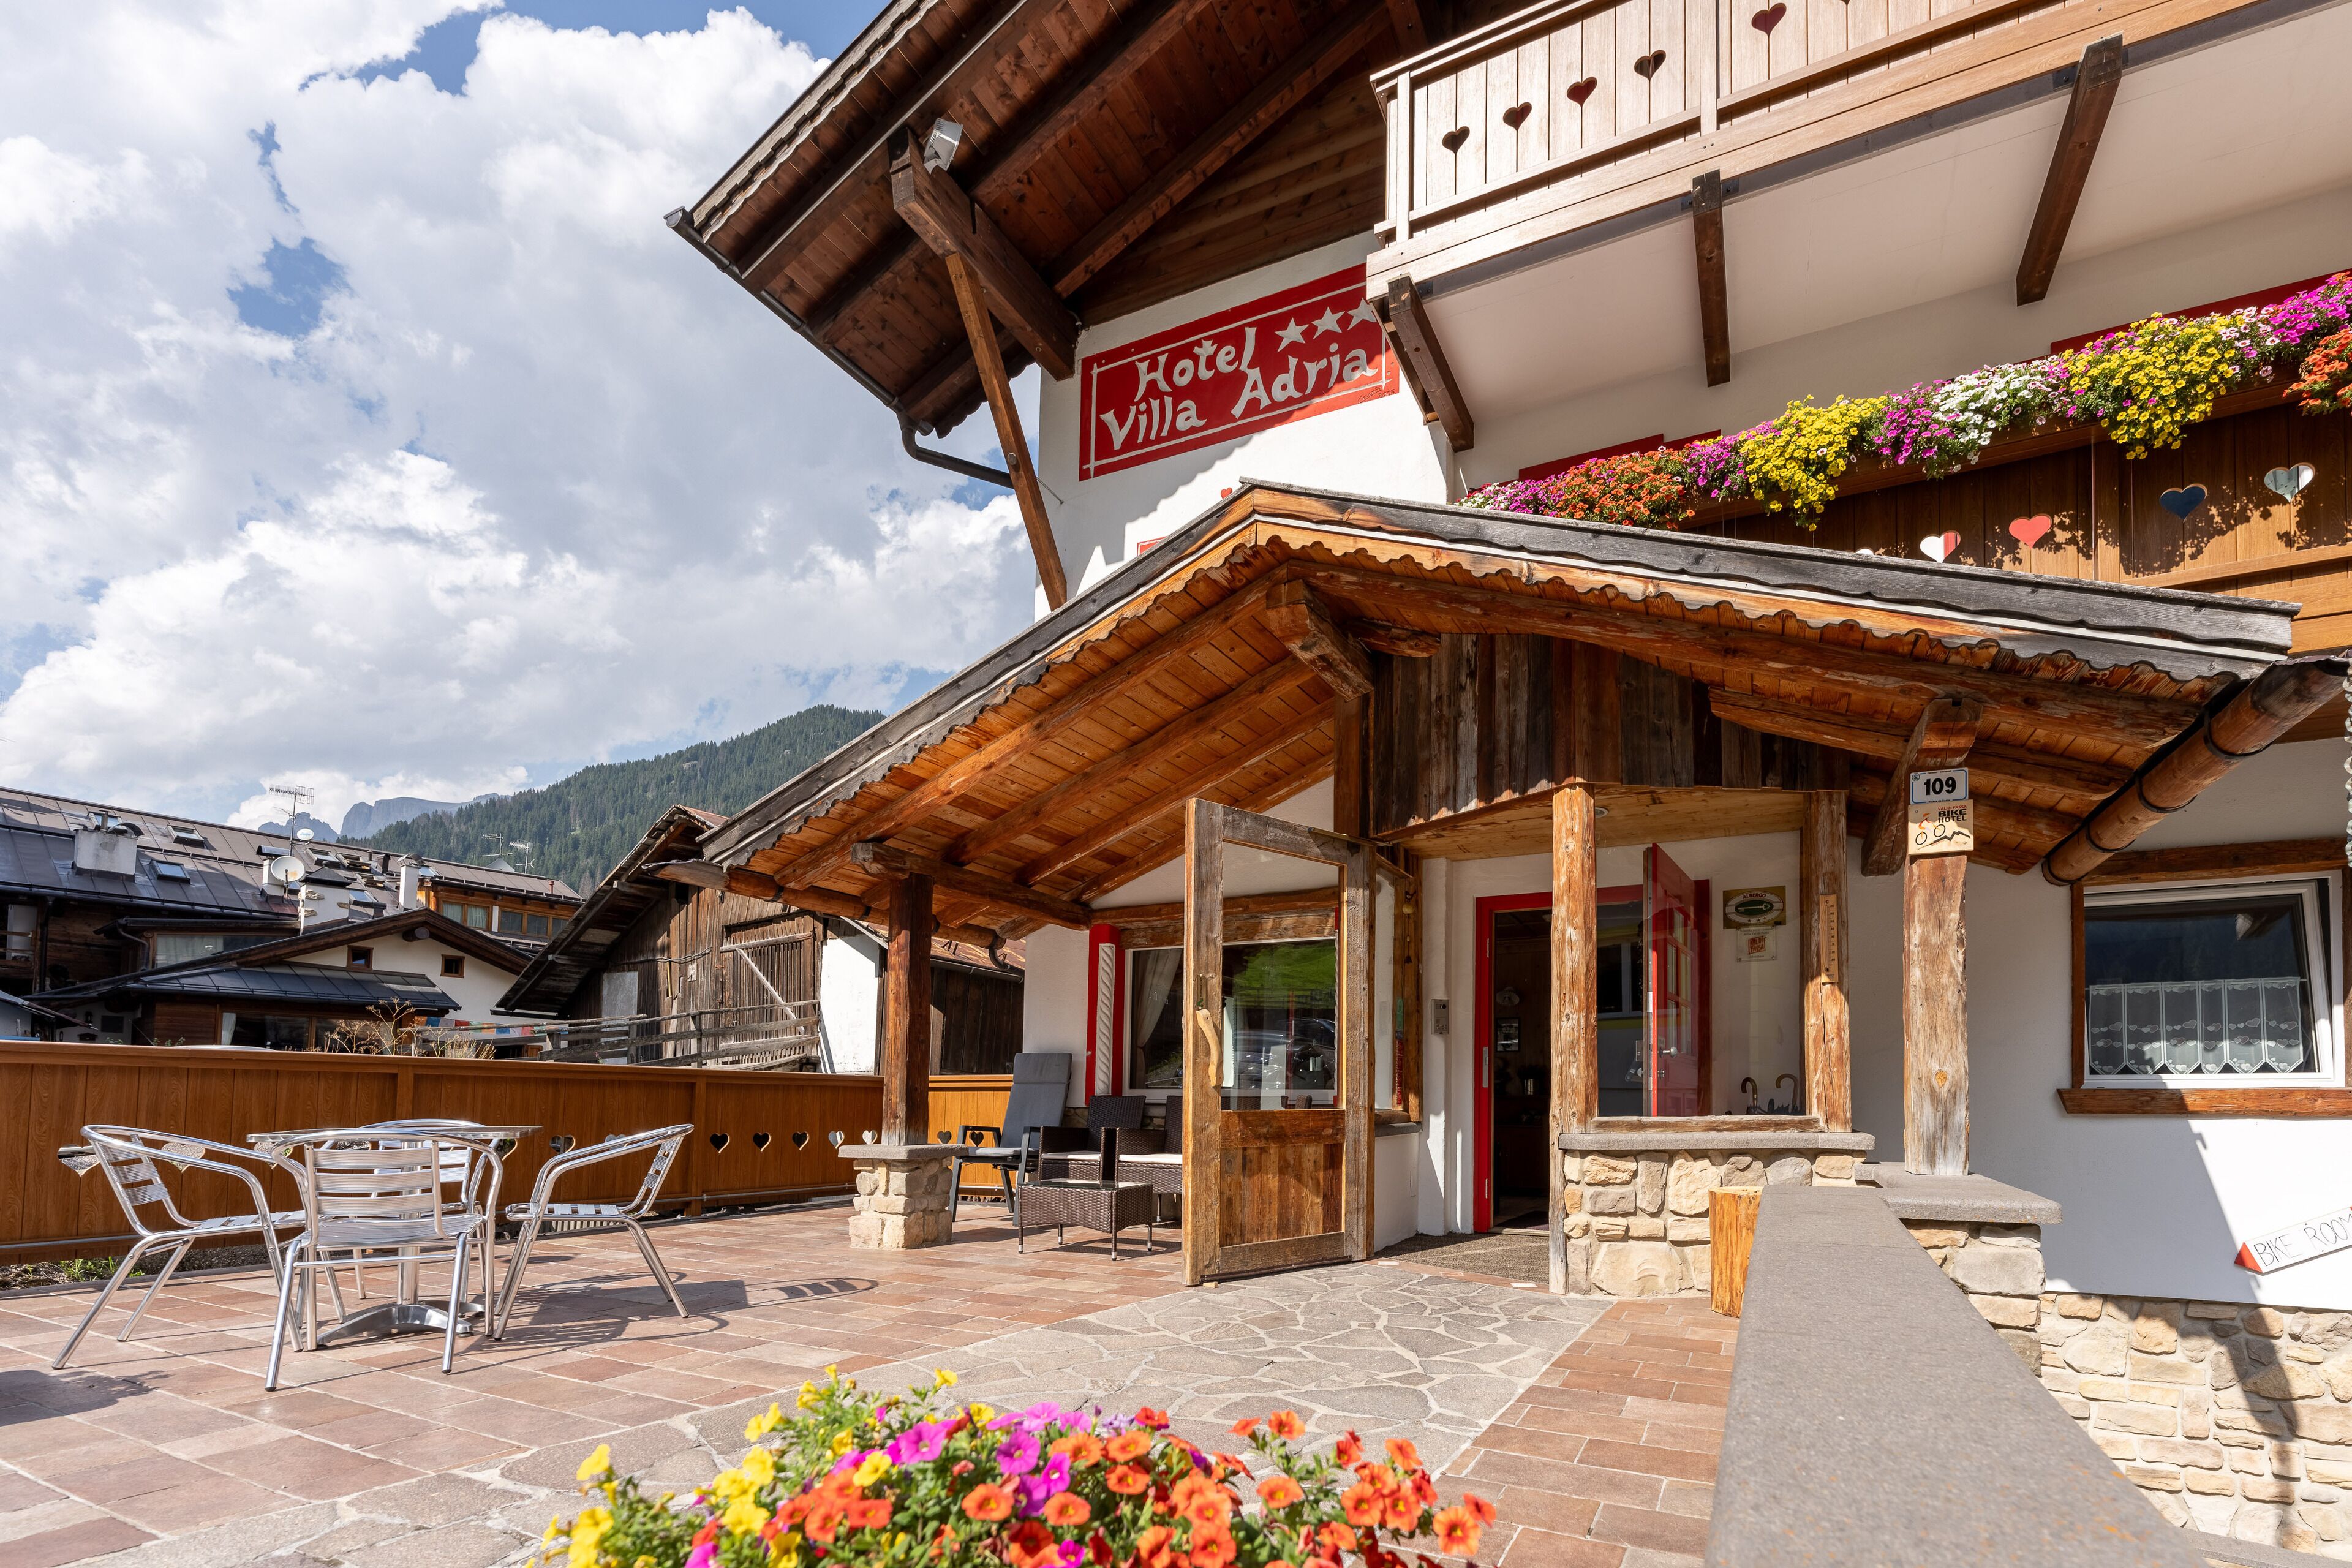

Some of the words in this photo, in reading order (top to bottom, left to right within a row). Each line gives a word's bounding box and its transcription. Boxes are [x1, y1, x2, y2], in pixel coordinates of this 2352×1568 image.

[1134, 326, 1257, 402] Hotel
[1100, 396, 1207, 450] Villa
[1231, 342, 1378, 419] Adria
[1924, 777, 1956, 796] 109
[2253, 1233, 2304, 1266] BIKE
